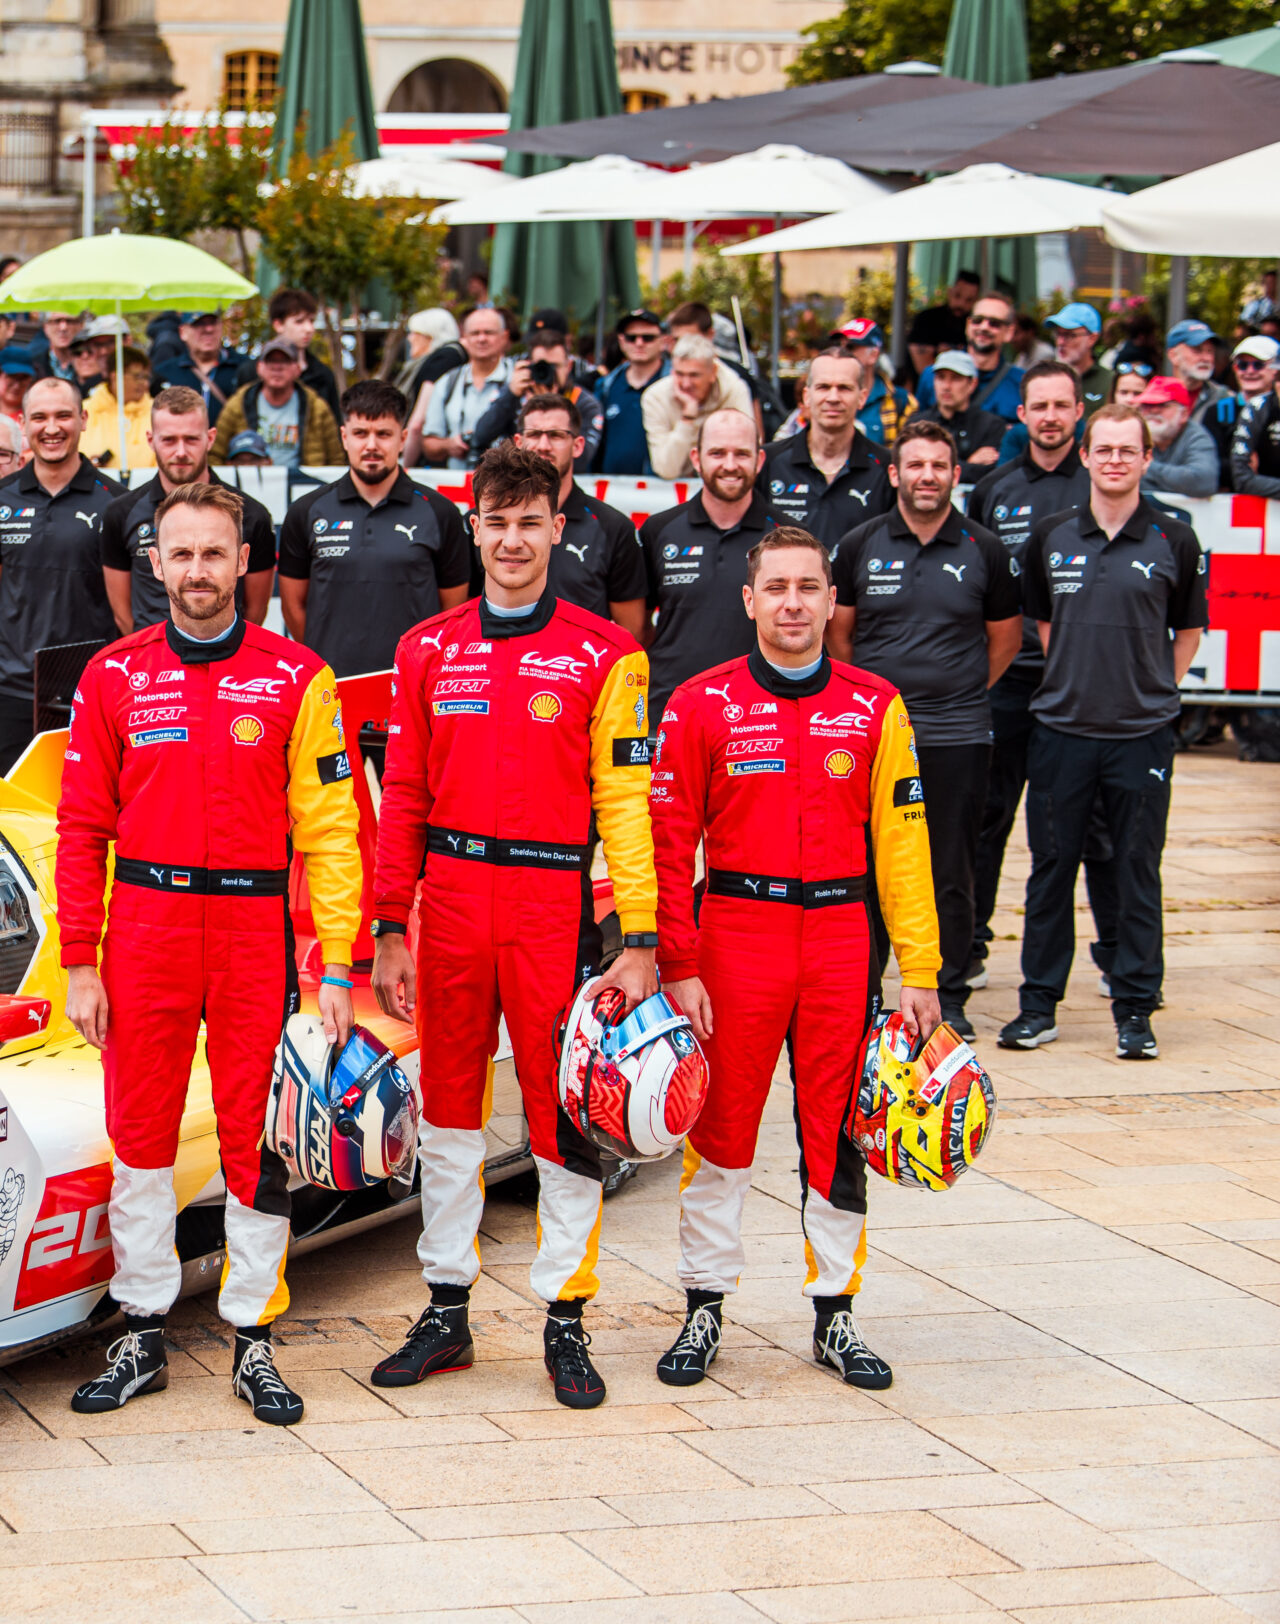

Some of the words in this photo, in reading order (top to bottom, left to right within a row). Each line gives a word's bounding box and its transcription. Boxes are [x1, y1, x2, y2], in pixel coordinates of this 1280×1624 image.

[441, 662, 487, 673] Motorsport
[520, 651, 588, 675] WEC
[219, 676, 286, 694] WEC
[434, 679, 490, 694] WRT
[134, 690, 183, 703] Motorsport
[447, 702, 483, 711] MICHELIN
[129, 707, 187, 726] WRT
[810, 711, 871, 728] WEC
[730, 723, 777, 735] Motorsport
[145, 731, 182, 741] MICHELIN
[630, 740, 649, 757] 24h
[726, 738, 783, 755] WRT
[743, 763, 780, 771] MICHELIN
[509, 848, 537, 858] Sheldon
[539, 851, 552, 859] Van
[553, 852, 565, 861] Der
[566, 854, 581, 862] Linde
[221, 877, 237, 886] René
[239, 878, 253, 887] Rast
[815, 890, 831, 898] Robin
[832, 888, 847, 896] Frijns
